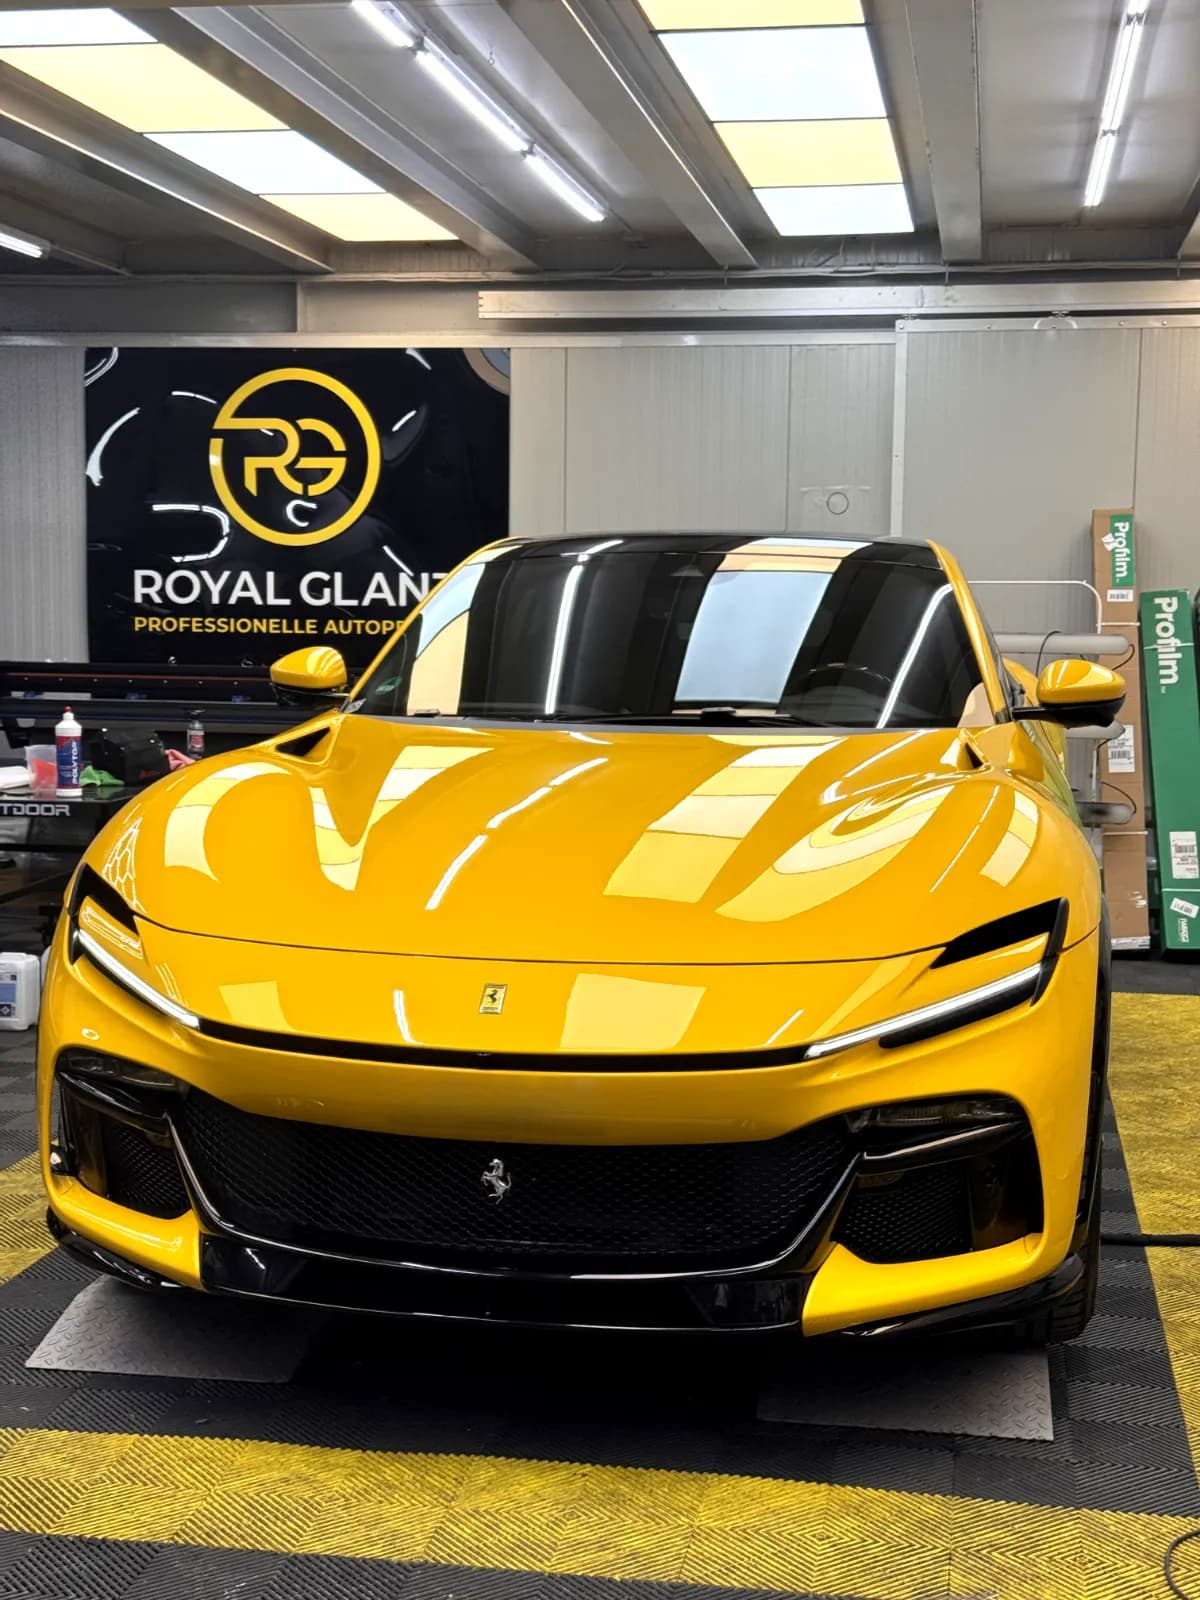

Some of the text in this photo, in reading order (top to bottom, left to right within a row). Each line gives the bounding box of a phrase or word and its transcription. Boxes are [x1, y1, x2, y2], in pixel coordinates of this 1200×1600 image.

[1114, 521, 1131, 577] Profilm
[133, 569, 292, 607] ROYAL
[134, 616, 318, 635] PROFESSIONELLE
[1153, 596, 1183, 685] Profilm
